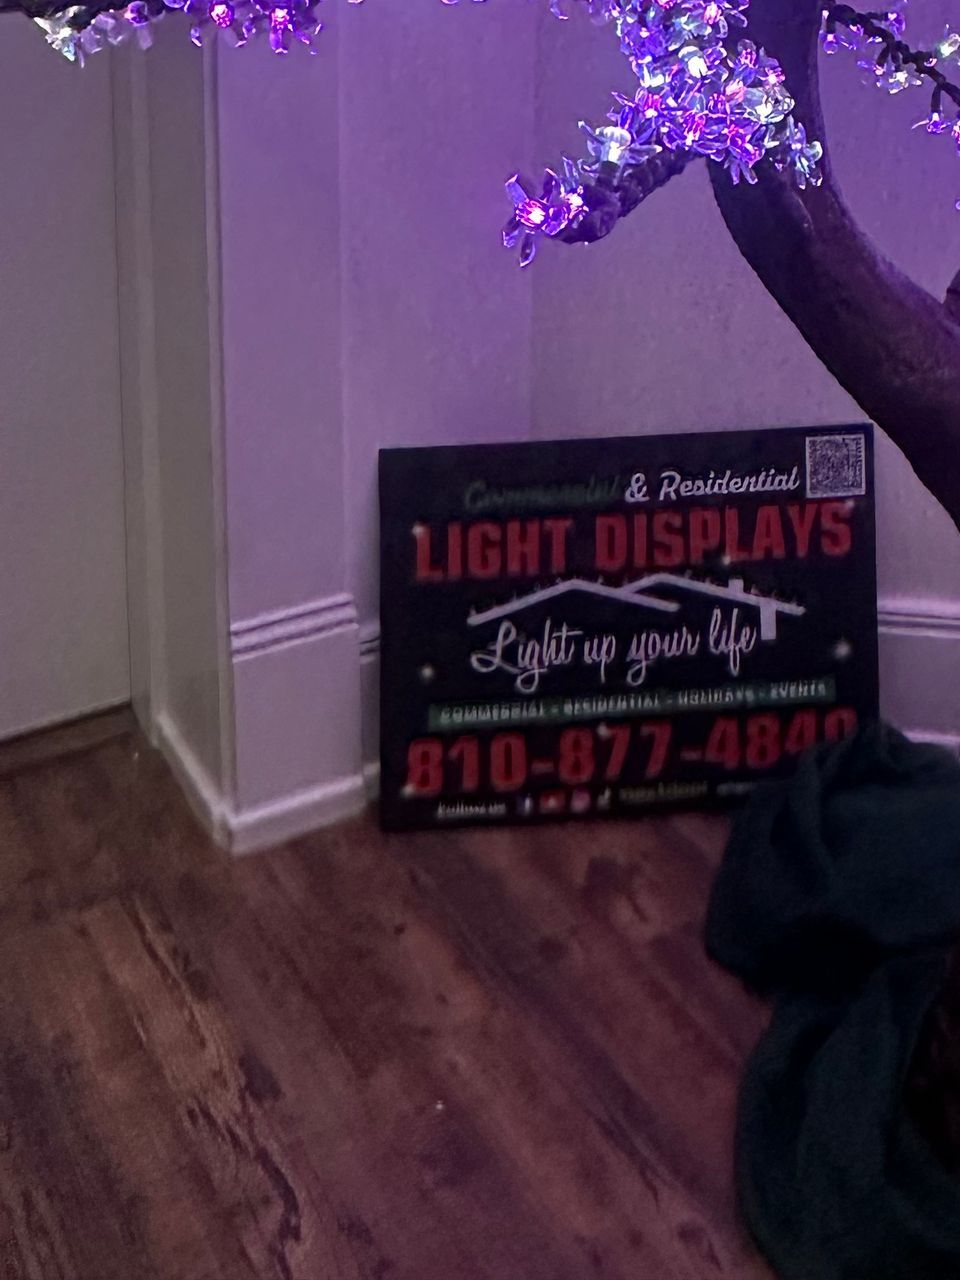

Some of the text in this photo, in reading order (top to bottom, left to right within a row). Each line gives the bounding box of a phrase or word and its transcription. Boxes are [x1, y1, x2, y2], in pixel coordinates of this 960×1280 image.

[624, 472, 650, 503] &
[658, 464, 801, 501] Residential
[415, 500, 855, 580] LIGHT DISPLAYS
[470, 607, 758, 693] Light up your life
